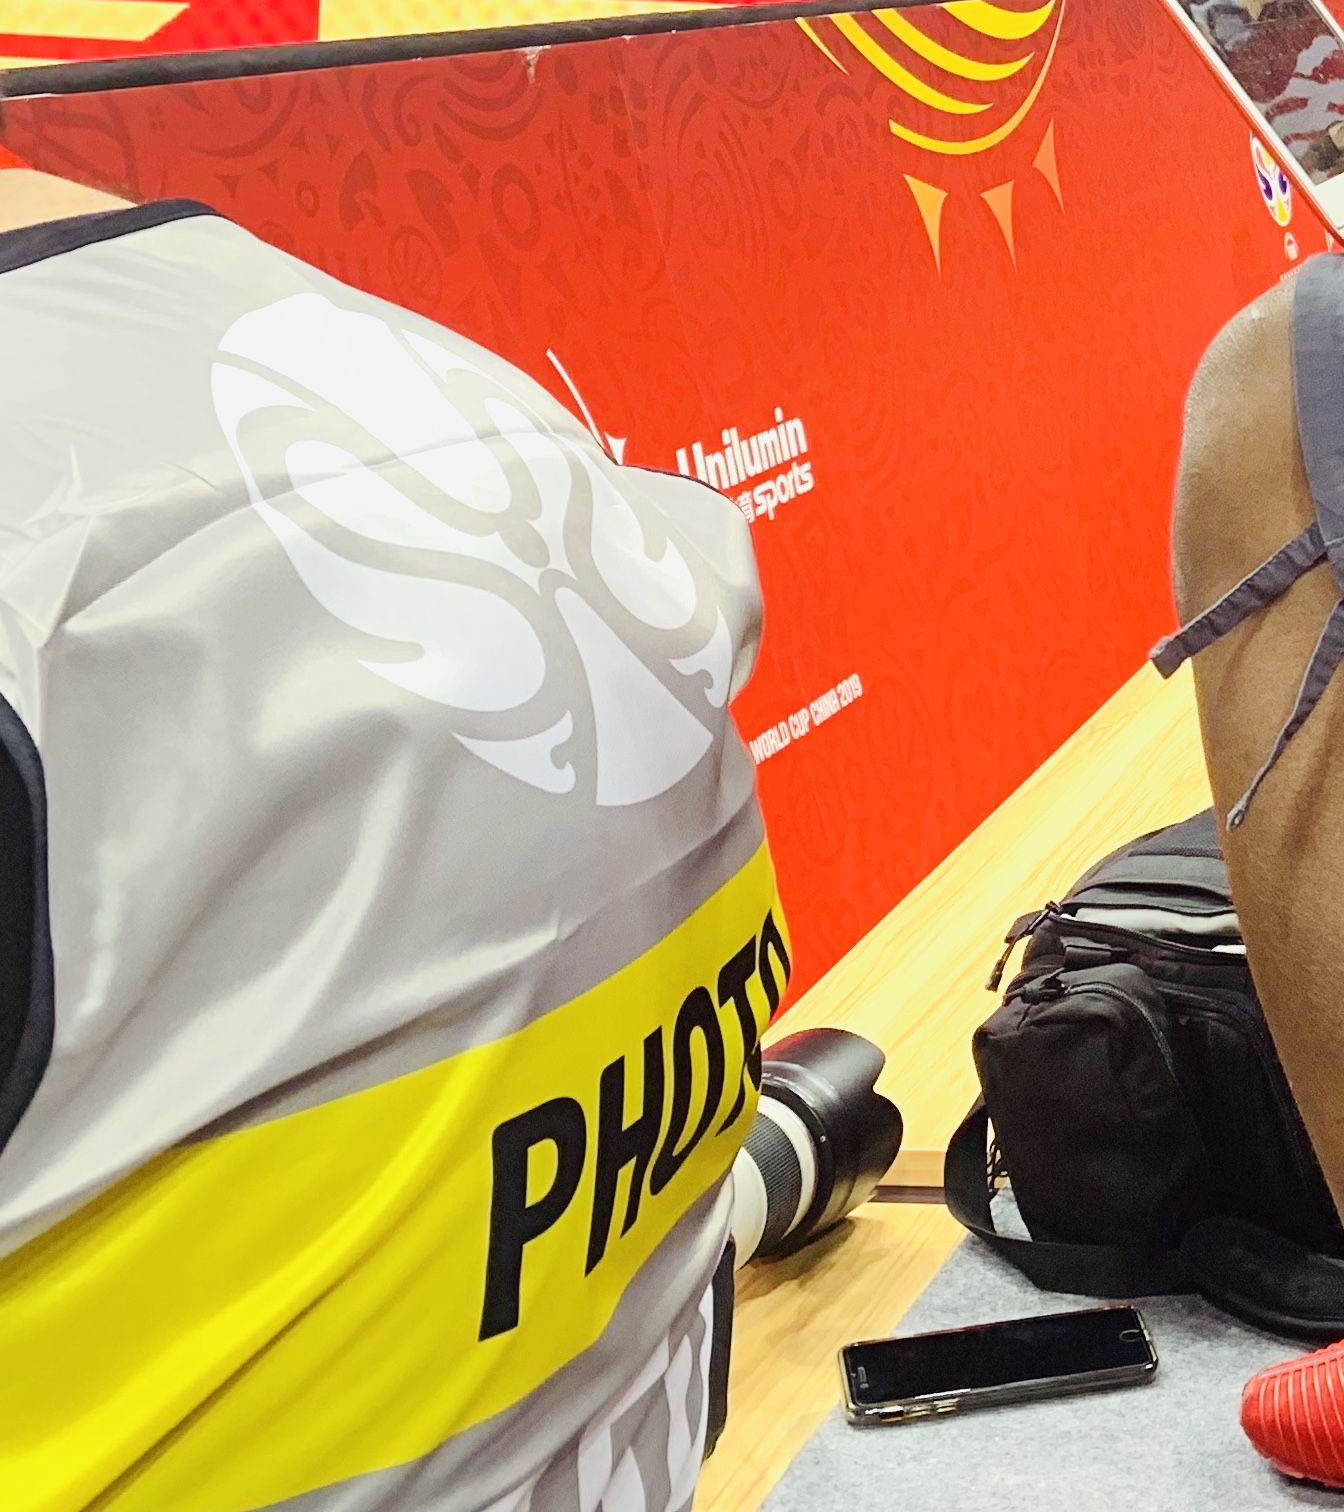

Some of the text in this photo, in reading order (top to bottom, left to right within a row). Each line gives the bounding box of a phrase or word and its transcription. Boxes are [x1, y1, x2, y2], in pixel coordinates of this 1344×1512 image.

[676, 406, 808, 490] Unilumin
[753, 461, 815, 521] sports
[749, 672, 863, 765] WORLD CUP CHINA 2019
